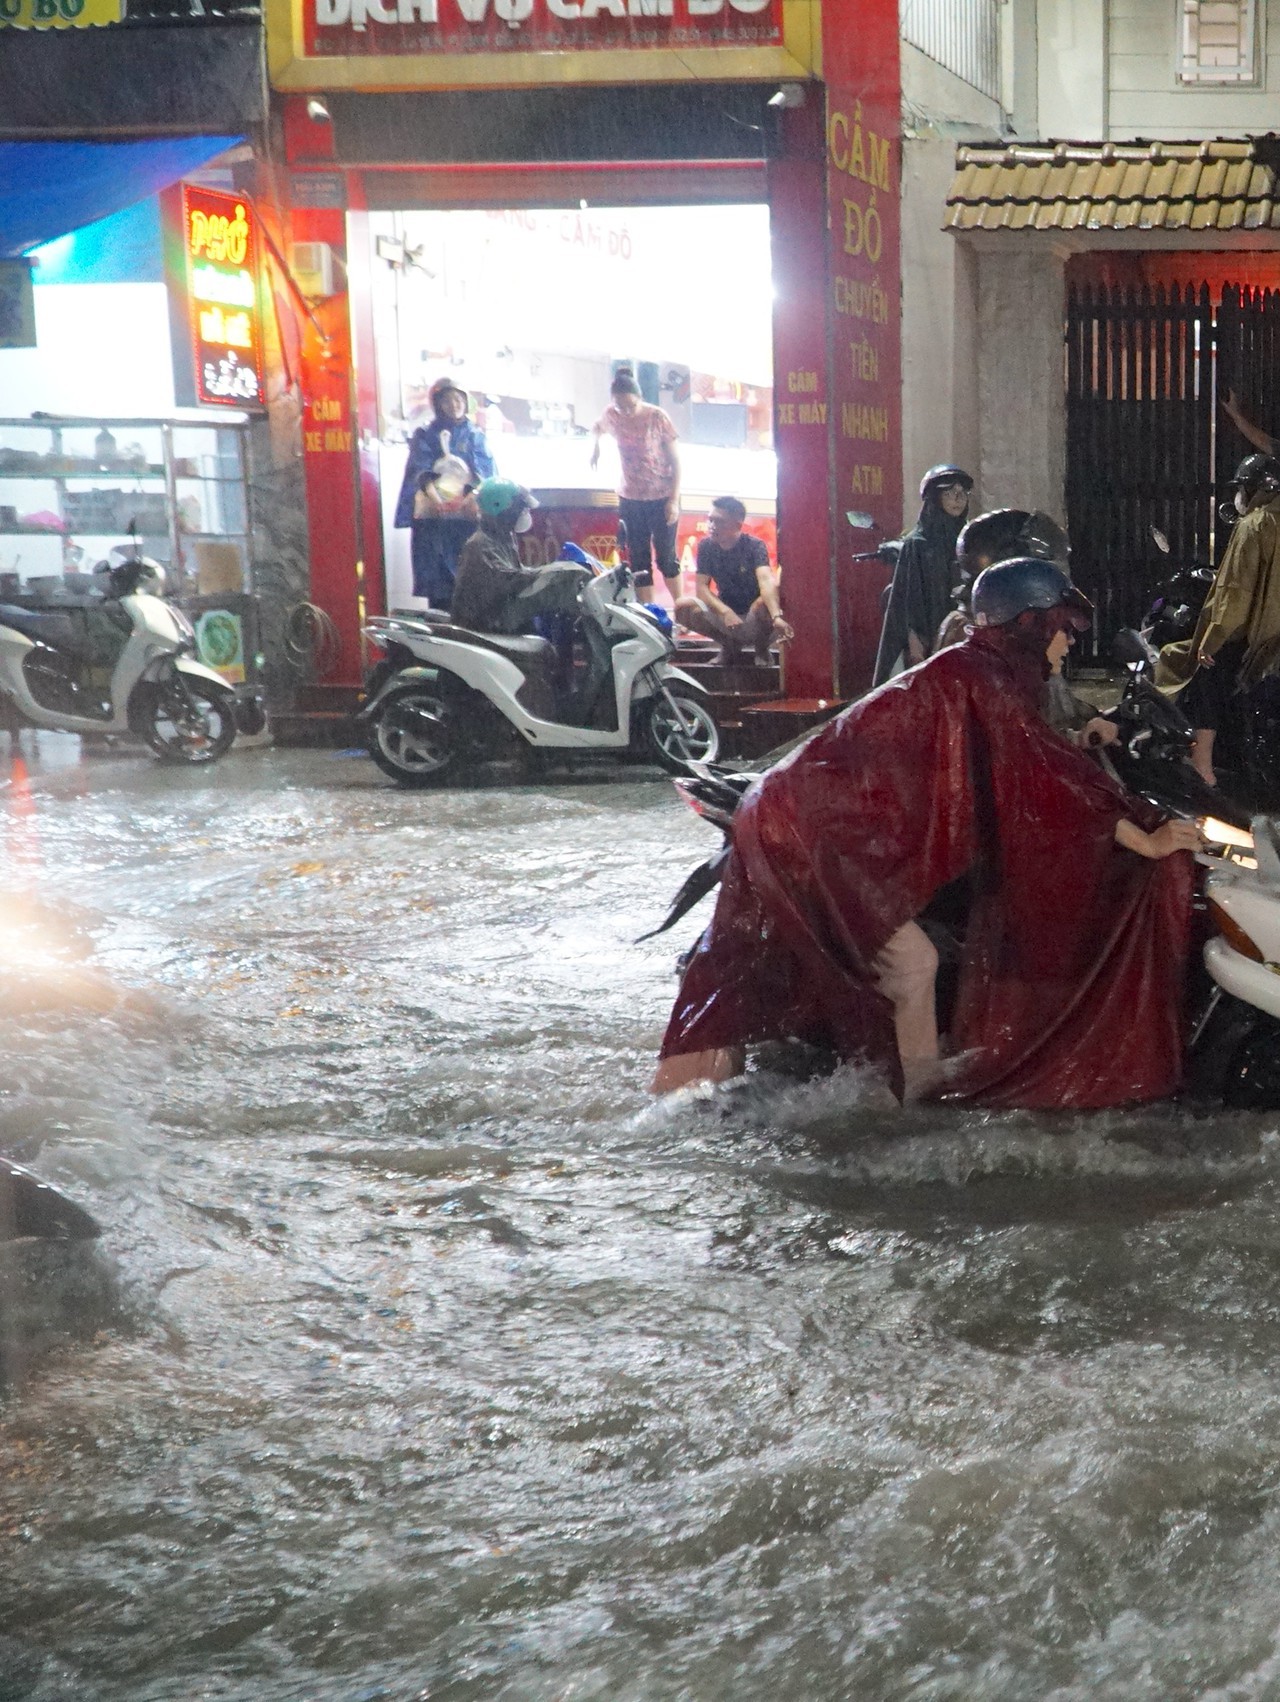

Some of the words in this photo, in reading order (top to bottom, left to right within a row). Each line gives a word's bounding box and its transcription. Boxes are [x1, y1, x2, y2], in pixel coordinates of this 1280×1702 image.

[191, 204, 249, 265] PHỞ
[843, 187, 882, 262] ĐỒ
[778, 403, 795, 425] XE
[841, 402, 888, 443] NHANH
[305, 433, 322, 451] XE
[852, 463, 884, 496] ATM
